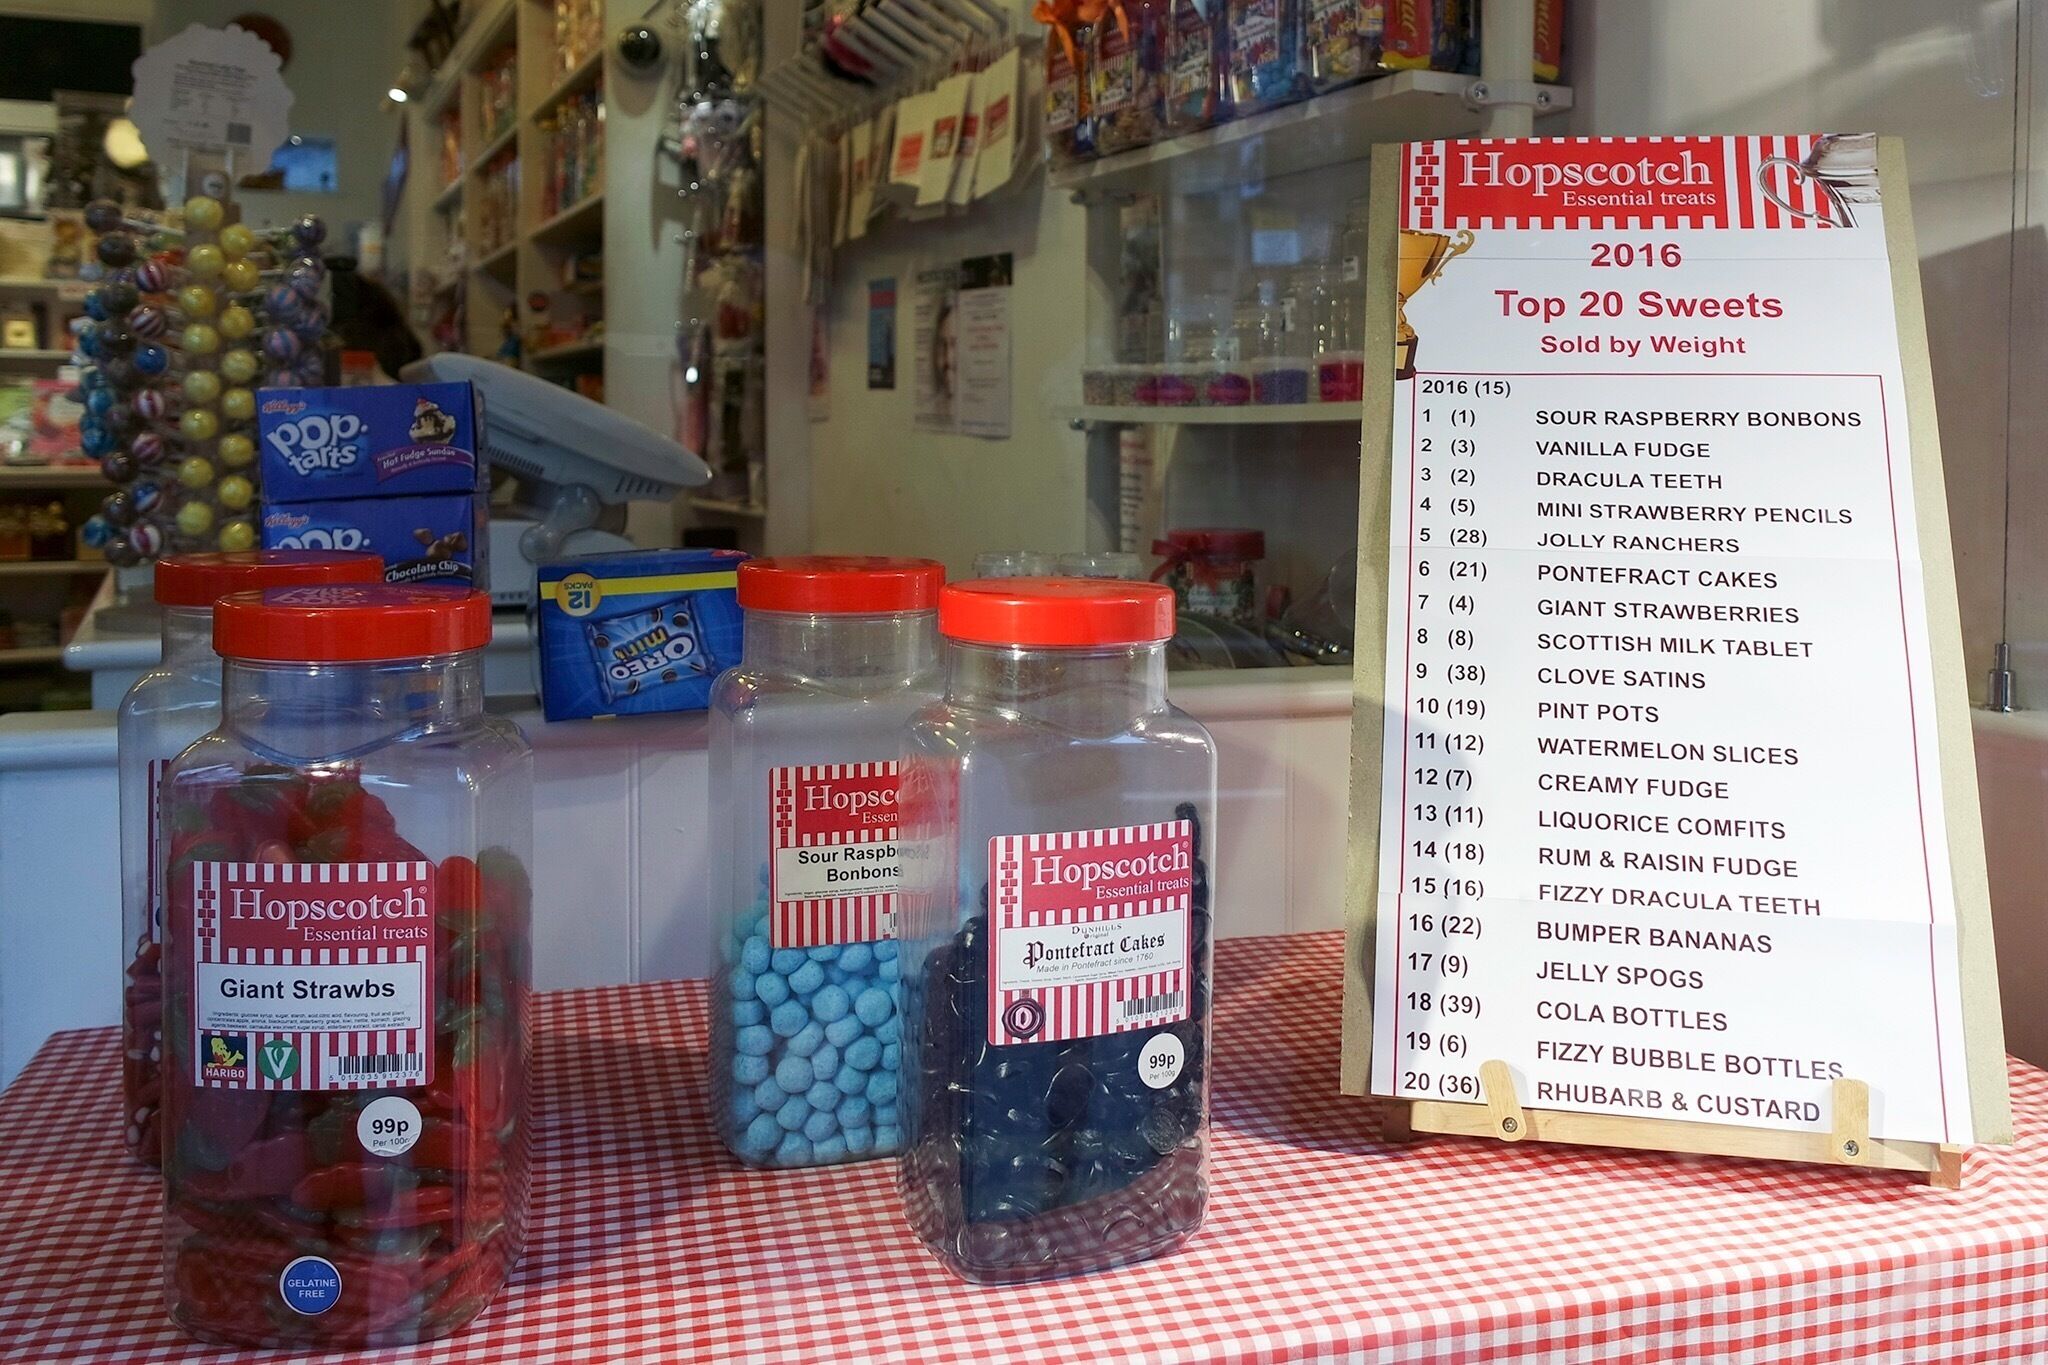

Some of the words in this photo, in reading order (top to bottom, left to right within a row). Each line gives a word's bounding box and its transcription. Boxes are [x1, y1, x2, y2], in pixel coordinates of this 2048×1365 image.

[1459, 151, 1712, 197] Hopscotch
[1563, 190, 1653, 207] Essential
[1661, 191, 1716, 206] treats
[1591, 243, 1681, 267] 2016
[1495, 290, 1565, 323] Top
[1580, 291, 1622, 317] 20
[1639, 291, 1783, 317] Sweets
[1541, 336, 1599, 353] Sold
[1610, 336, 1641, 357] by
[1650, 336, 1745, 357] Weight
[1423, 380, 1467, 394] 2016
[1475, 381, 1510, 398] (15)
[1423, 409, 1429, 422] 1
[1452, 410, 1475, 427] (1)
[1536, 411, 1596, 425] SOUR
[1605, 411, 1739, 426] RASPBERRY
[1748, 412, 1861, 426] BONBONS
[289, 444, 357, 476] tarts
[1421, 439, 1431, 451] 2
[1451, 439, 1475, 457] (3)
[1536, 441, 1627, 456] VANILLA
[1635, 443, 1710, 457] FUDGE
[1421, 468, 1431, 481] 3
[1451, 469, 1475, 486] (2)
[1538, 472, 1644, 487] DRACULA
[1650, 474, 1721, 489] TEETH
[1420, 497, 1431, 510] 4
[1451, 498, 1475, 516] (5)
[1538, 503, 1581, 517] MINI
[1590, 504, 1746, 521] STRAWBERRY
[1755, 508, 1852, 523] PENCILS
[1420, 528, 1430, 541] 5
[1450, 529, 1487, 547] (28)
[1538, 533, 1605, 548] JOLLY
[1614, 536, 1739, 552] RANCHERS
[386, 563, 436, 582] Chocolate
[439, 561, 458, 571] Chip
[1419, 561, 1429, 576] 6
[1450, 561, 1486, 581] (21)
[1539, 565, 1690, 585] PONTEFRACT
[1699, 571, 1777, 588] CAKES
[564, 582, 593, 590] PACKS
[1419, 595, 1428, 609] 7
[1449, 595, 1474, 615] (4)
[1538, 600, 1606, 616] GIANT
[1614, 603, 1799, 623] STRAWBERRIES
[1418, 628, 1427, 644] 8
[1449, 630, 1473, 650] (8)
[1538, 634, 1651, 652] SCOTTISH
[1661, 638, 1715, 654] MILK
[1723, 640, 1812, 657] TABLET
[610, 633, 694, 680] OREO
[1417, 663, 1427, 678] 9
[1448, 665, 1485, 685] (38)
[1538, 668, 1614, 685] CLOVE
[1624, 671, 1705, 688] SATINS
[1417, 698, 1438, 713] 10
[1447, 699, 1485, 720] (19)
[1539, 703, 1589, 719] PINT
[1598, 705, 1658, 722] POTS
[1416, 733, 1434, 749] 11
[1445, 734, 1483, 755] (12)
[1538, 738, 1703, 760] WATERMELON
[1714, 746, 1798, 765] SLICES
[1415, 768, 1437, 785] 12
[1446, 769, 1471, 791] (7)
[1539, 774, 1638, 794] CREAMY
[1648, 779, 1728, 798] FUDGE
[1414, 804, 1436, 821] 13
[1446, 806, 1483, 828] (11)
[1540, 811, 1668, 833] LIQUORICE
[1678, 818, 1785, 839] COMFITS
[799, 850, 838, 864] Sour
[1413, 841, 1436, 857] 14
[1445, 842, 1484, 865] (18)
[1540, 848, 1590, 866] RUM
[1600, 851, 1614, 868] &
[1624, 852, 1703, 872] RAISIN
[1714, 857, 1798, 877] FUDGE
[1096, 880, 1153, 900] Essential
[1157, 876, 1189, 891] treats
[1412, 877, 1435, 894] 15
[1444, 878, 1483, 901] (16)
[1540, 885, 1603, 903] FIZZY
[1613, 889, 1732, 911] DRACULA
[1739, 896, 1820, 916] TEETH
[304, 926, 377, 941] Essential
[383, 926, 427, 939] treats
[1410, 914, 1433, 932] 16
[1442, 915, 1481, 939] (22)
[1538, 922, 1640, 945] BUMPER
[1650, 929, 1771, 953] BANANAS
[1023, 940, 1115, 969] Pontefract
[1121, 933, 1165, 953] Cakes
[1037, 964, 1059, 973] Made
[1062, 963, 1069, 971] in
[1072, 958, 1112, 970] Pontefract
[1114, 956, 1133, 965] since
[1136, 952, 1153, 961] 1760
[1409, 953, 1432, 971] 17
[1441, 955, 1467, 978] (9)
[1537, 962, 1608, 982] JELLY
[1617, 967, 1703, 989] SPOGS
[221, 978, 284, 999] Giant
[293, 979, 395, 999] Strawbs
[1408, 992, 1431, 1011] 18
[1441, 994, 1480, 1019] (39)
[1537, 1001, 1605, 1022] COLA
[1613, 1006, 1727, 1031] BOTTLES
[1150, 1053, 1175, 1069] 99p
[1407, 1032, 1430, 1050] 19
[1440, 1034, 1466, 1058] (6)
[1538, 1041, 1603, 1063] FIZZY
[1613, 1047, 1715, 1072] BUBBLE
[1725, 1055, 1843, 1080] BOTTLES
[206, 1068, 244, 1079] HARIBO
[1405, 1072, 1429, 1090] 20
[1439, 1074, 1480, 1099] (36)
[1538, 1082, 1662, 1108] RHUBARB
[1672, 1092, 1688, 1111] &
[1698, 1095, 1819, 1121] CUSTARD
[372, 1118, 408, 1136] 99p
[288, 1279, 336, 1287] GELATINE
[299, 1290, 325, 1298] FREE
